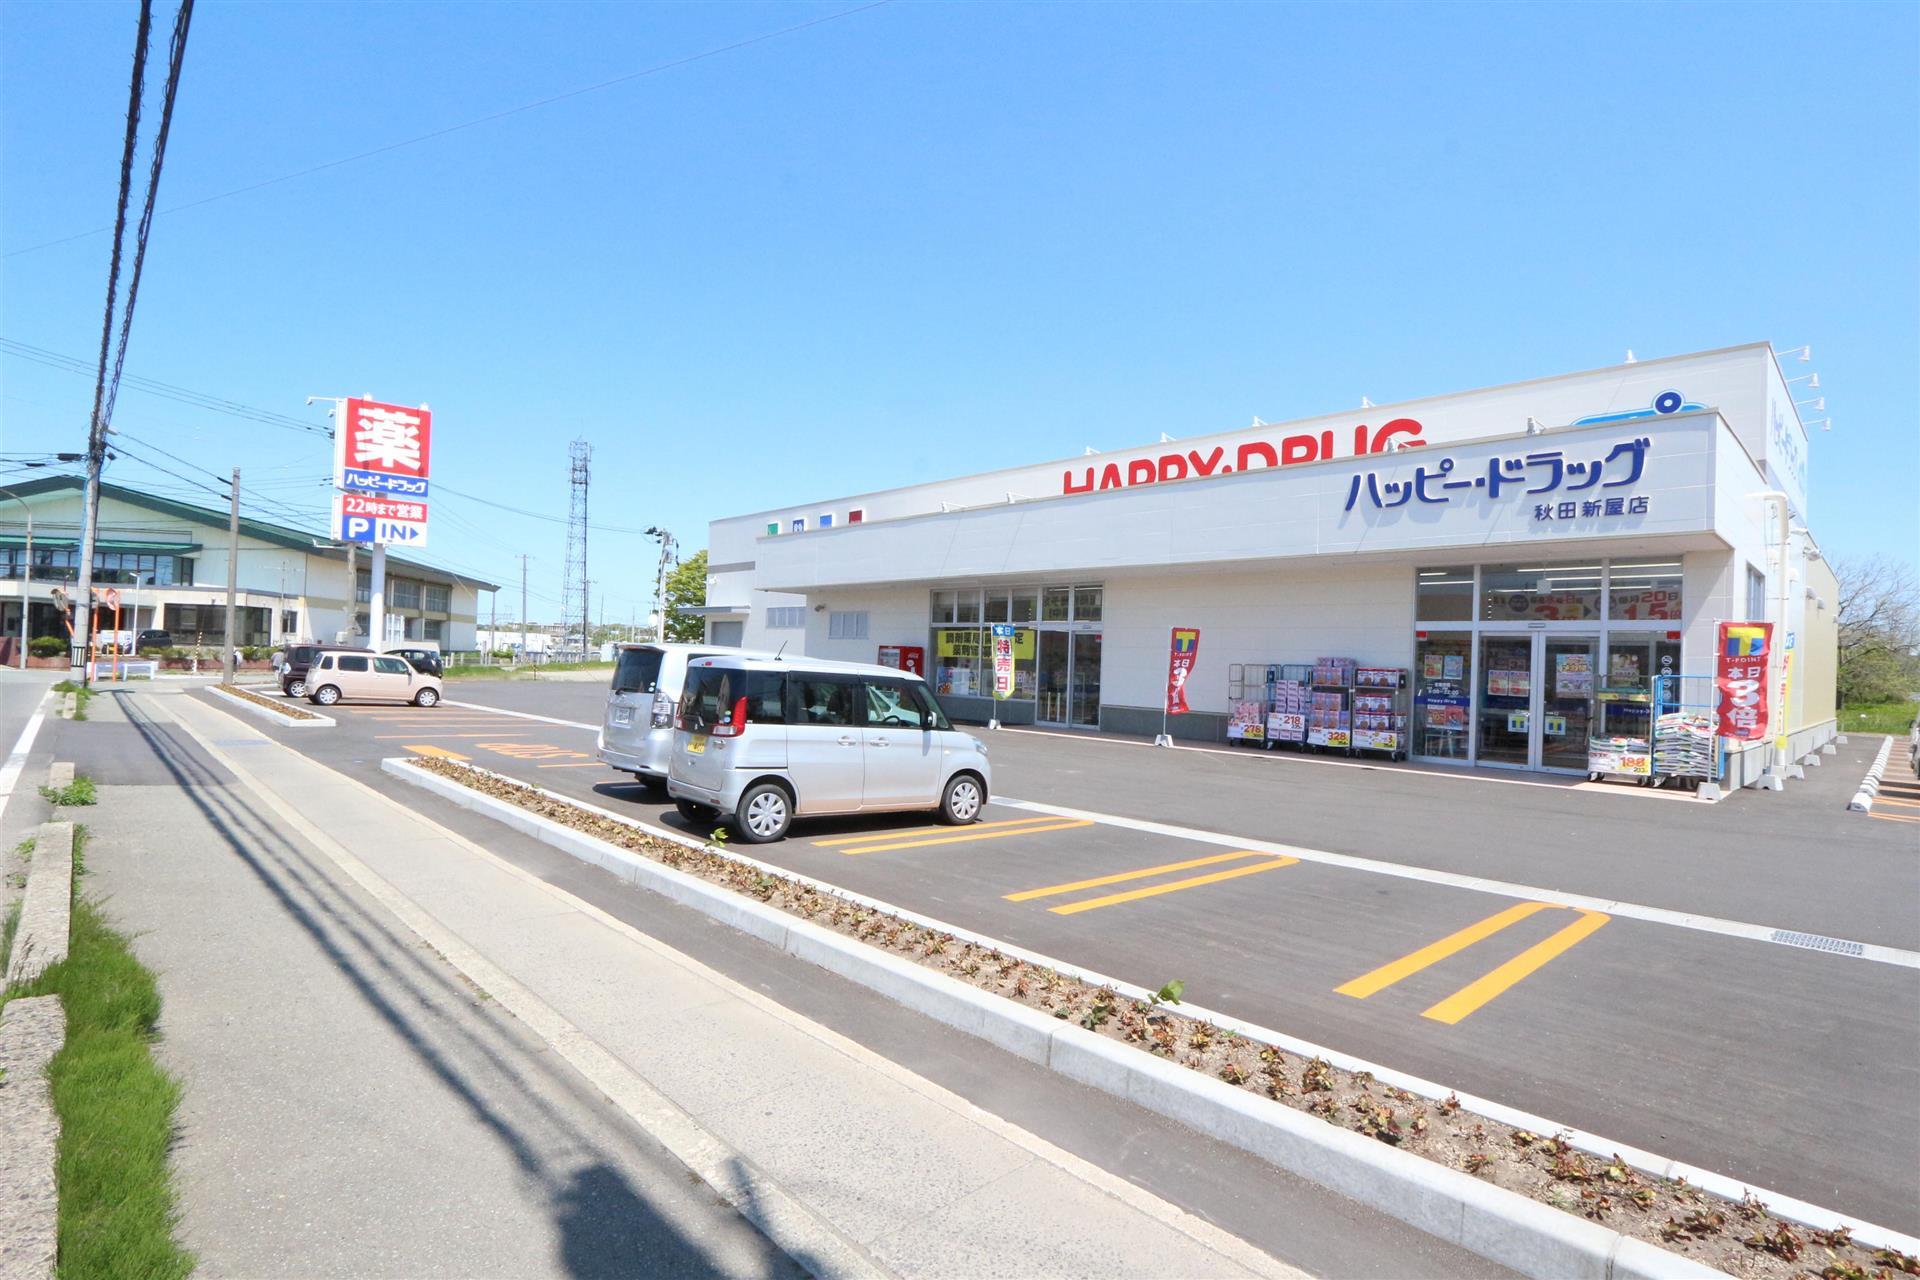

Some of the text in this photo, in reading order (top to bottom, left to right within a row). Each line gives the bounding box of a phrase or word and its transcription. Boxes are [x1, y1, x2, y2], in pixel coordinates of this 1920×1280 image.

[354, 408, 421, 470] 薬
[346, 497, 424, 520] 22時まで営業
[1534, 496, 1650, 521] 秋田新屋店
[349, 517, 369, 538] P
[381, 523, 407, 540] IN
[1176, 632, 1196, 652] T
[1727, 627, 1765, 656] T
[997, 639, 1010, 690] 特売日
[1727, 667, 1761, 679] 本日
[1284, 715, 1301, 725] 218
